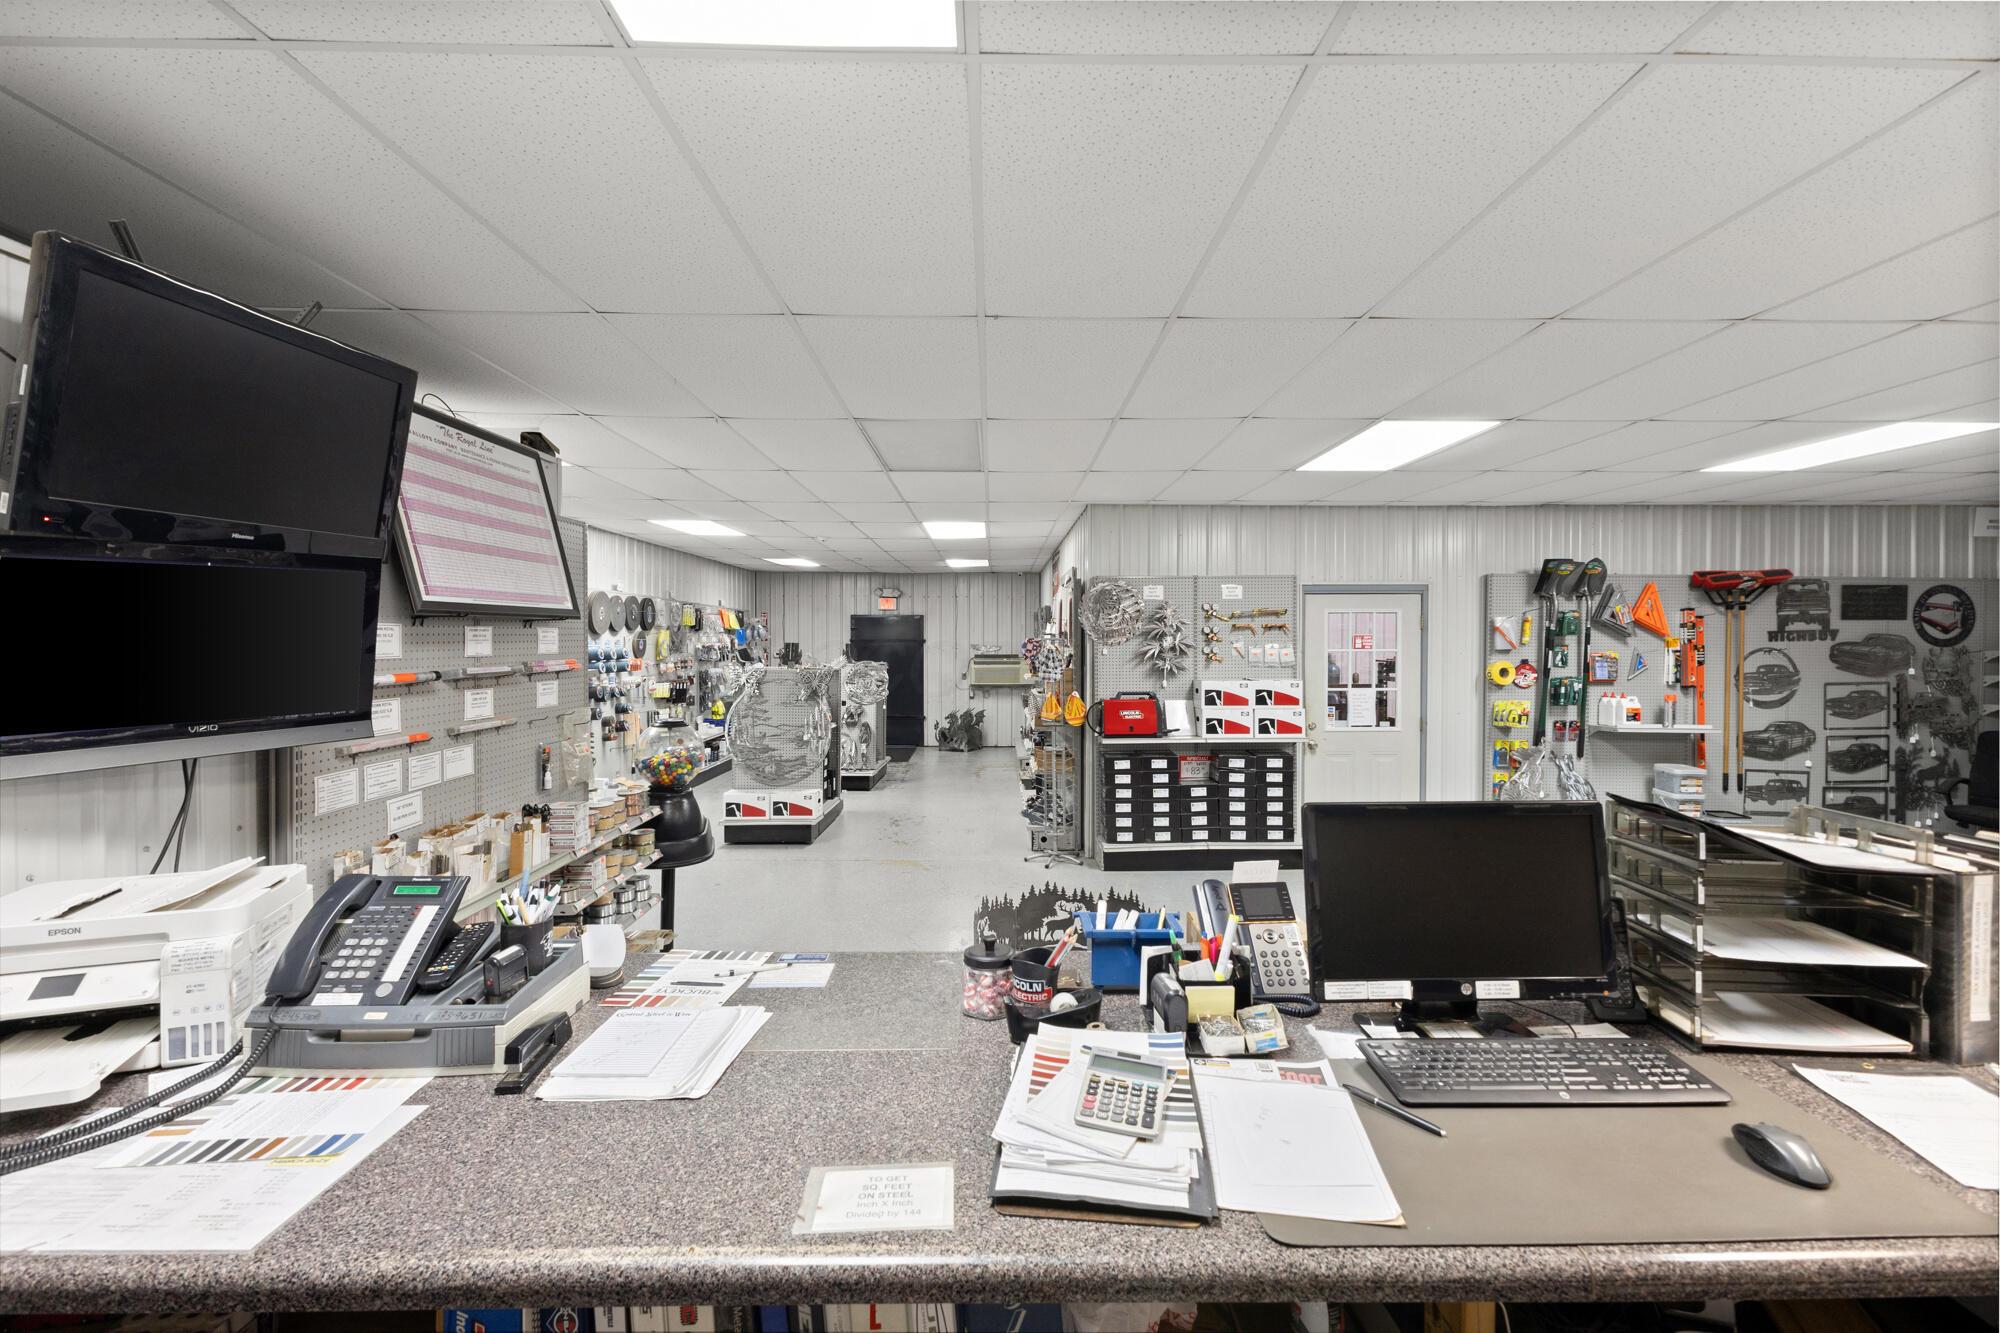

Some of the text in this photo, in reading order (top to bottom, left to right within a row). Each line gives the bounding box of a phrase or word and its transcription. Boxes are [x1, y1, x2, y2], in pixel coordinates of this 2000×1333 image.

[455, 433, 477, 449] Royal
[188, 724, 218, 733] VIZIO
[48, 928, 81, 936] EPSON
[858, 1191, 914, 1200] ON STEEL
[846, 1210, 884, 1219] Divided
